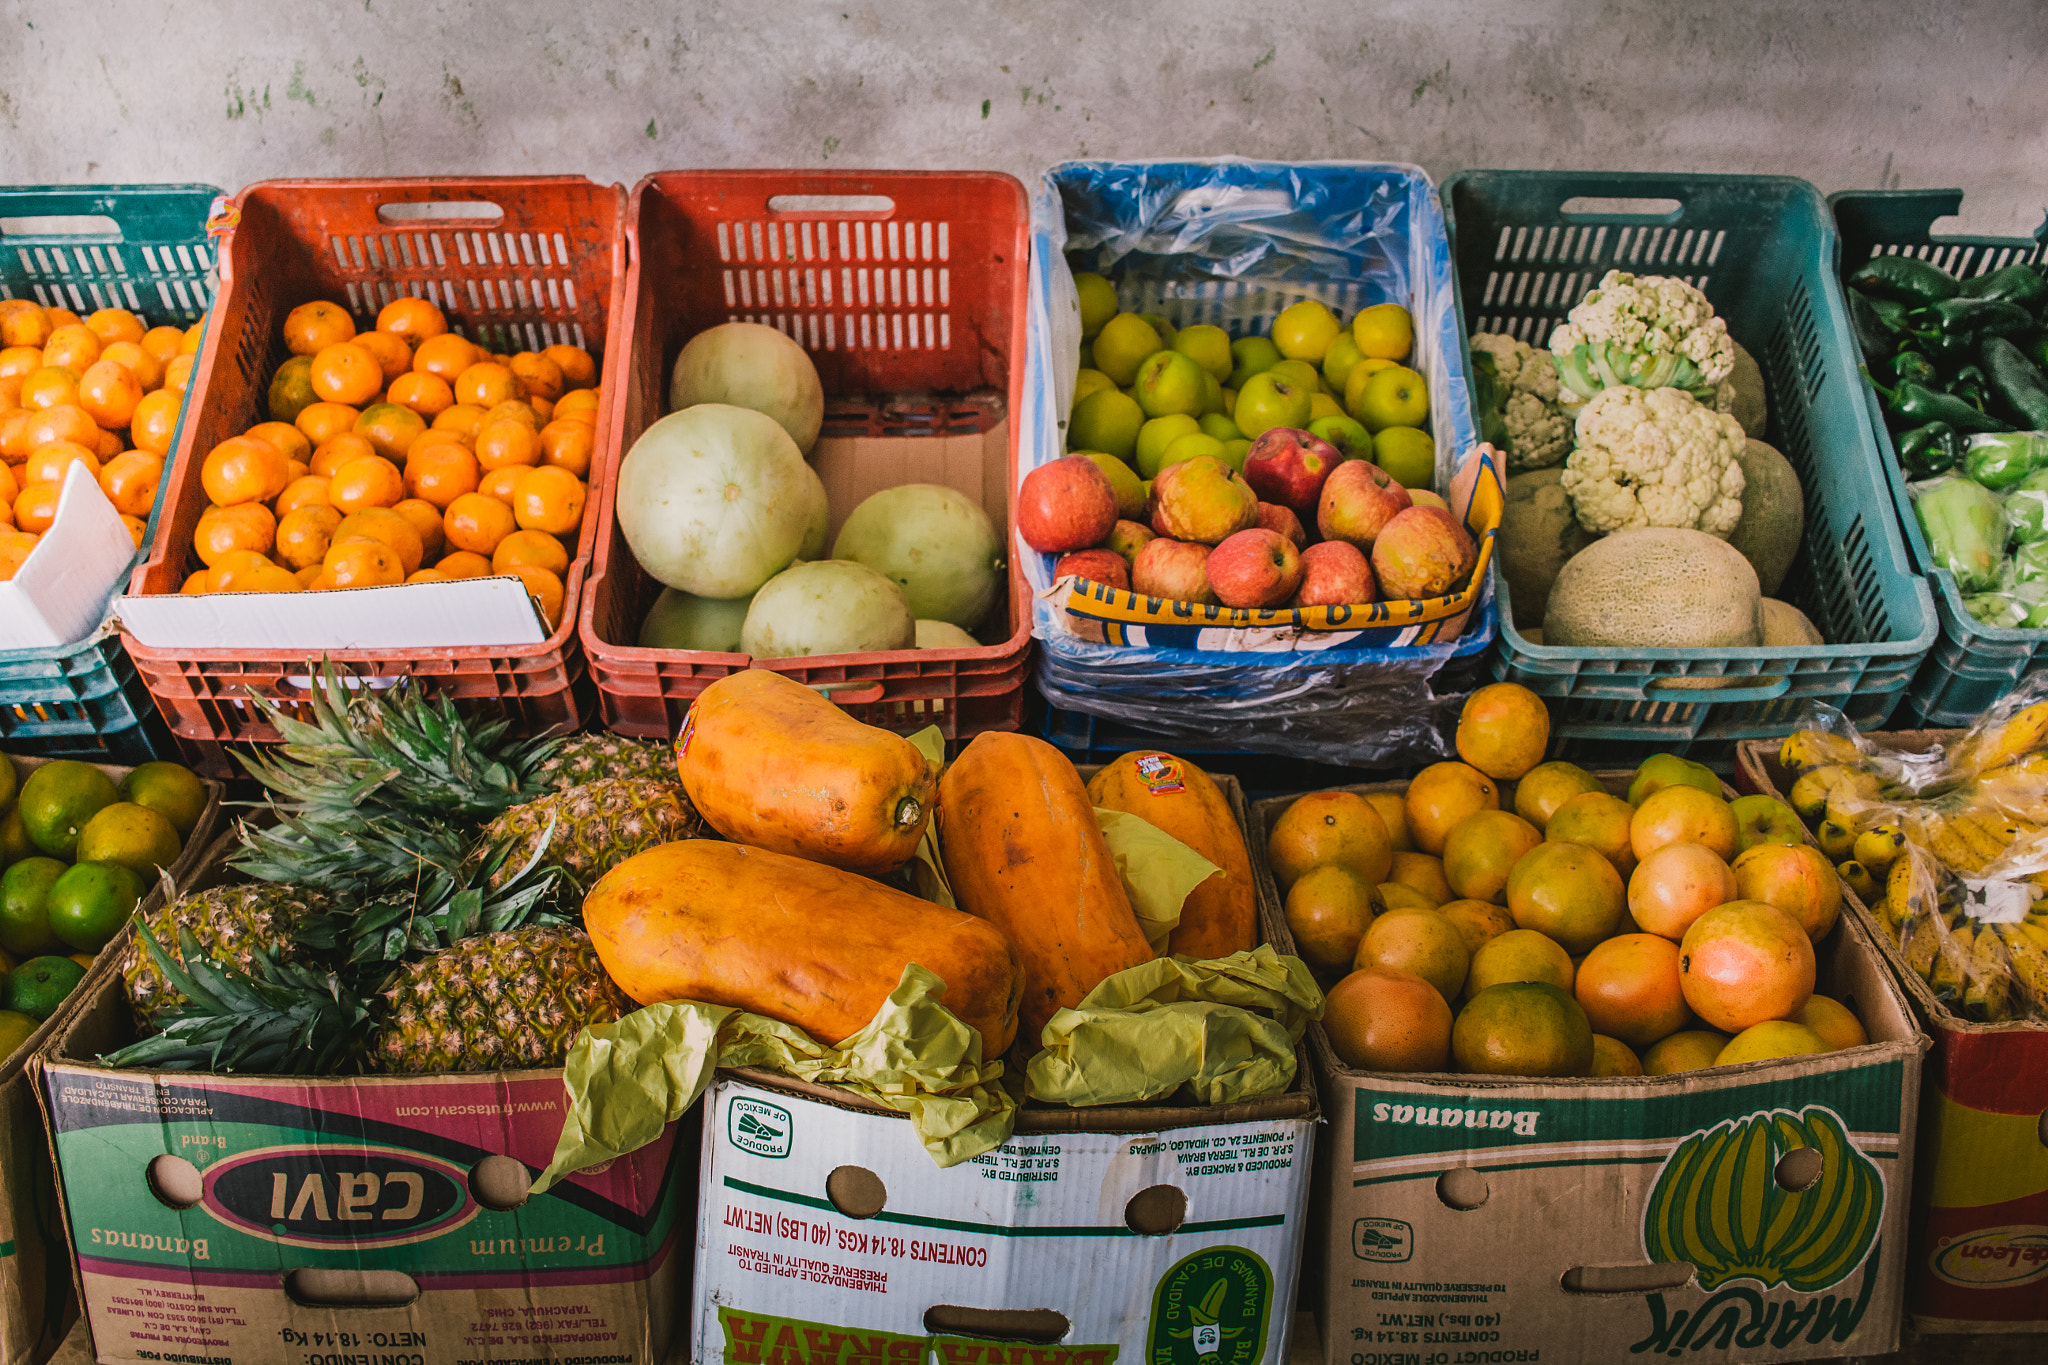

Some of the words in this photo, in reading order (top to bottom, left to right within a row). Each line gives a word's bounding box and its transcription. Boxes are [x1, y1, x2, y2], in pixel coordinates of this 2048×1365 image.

[64, 1087, 105, 1098] CALIDAD
[95, 1082, 140, 1093] TRANSITO
[156, 1088, 170, 1096] EN
[61, 1095, 137, 1112] THIABENDAZOLE
[120, 1093, 178, 1105] CONSERVAR
[182, 1098, 206, 1106] PARA
[139, 1104, 150, 1113] DE
[154, 1105, 213, 1115] APLICACION
[396, 1101, 557, 1118] www.frutascavi.com
[737, 1103, 771, 1116] MEXICO
[773, 1112, 786, 1121] OF
[1373, 1103, 1541, 1136] Bananas
[181, 1135, 227, 1149] Brand
[736, 1135, 783, 1153] PRODUCE
[1211, 1138, 1226, 1148] CD.
[1228, 1136, 1241, 1146] 2A.
[1243, 1132, 1284, 1145] PONIENTE
[1004, 1145, 1016, 1154] DE
[1129, 1143, 1166, 1155] CHIAPAS
[1169, 1139, 1209, 1151] HIDALGO,
[1271, 1144, 1293, 1155] S.P.R.
[1018, 1146, 1061, 1156] CENTRAL
[1208, 1149, 1238, 1162] TIERRA
[1240, 1148, 1256, 1159] R.L.
[1257, 1147, 1269, 1157] DE
[968, 1155, 999, 1166] TIERR
[1001, 1158, 1018, 1168] R.L.
[1035, 1158, 1059, 1168] S.P.R.
[1177, 1152, 1206, 1164] BRAVA
[1020, 1159, 1032, 1169] DE
[1201, 1163, 1236, 1176] PACKED
[1238, 1163, 1243, 1172] &
[1246, 1158, 1292, 1172] PRODUCED
[981, 1169, 996, 1180] BY:
[999, 1171, 1058, 1182] DISTRIBUTED
[1186, 1167, 1199, 1177] BY:
[271, 1172, 424, 1236] cavi
[724, 1205, 773, 1232] NET.WT
[777, 1211, 808, 1240] LBS)
[812, 1222, 831, 1247] (40
[91, 1228, 210, 1260] Bananas
[835, 1229, 868, 1252] KGS.
[469, 1234, 606, 1260] Premium
[872, 1236, 906, 1258] 18.14
[728, 1244, 770, 1262] TRANSIT
[910, 1240, 987, 1268] CONTENTS
[1364, 1249, 1402, 1258] PRODUCE
[739, 1259, 752, 1270] TO
[773, 1254, 783, 1264] IN
[785, 1256, 829, 1272] QUALITY
[1202, 1256, 1225, 1269] DE
[755, 1262, 798, 1278] APPLIED
[833, 1264, 888, 1282] PRESERVE
[801, 1270, 887, 1293] THIABENDAZOLE
[1351, 1279, 1390, 1290] TRANSIT
[1392, 1282, 1402, 1290] IN
[1403, 1282, 1442, 1292] QUALITY
[137, 1287, 151, 1296] N.L.
[1166, 1263, 1198, 1320] CALIDAD
[1230, 1259, 1259, 1317] BANANAS
[1444, 1283, 1492, 1292] PRESERVE
[1494, 1284, 1505, 1292] TO
[153, 1289, 205, 1301] MONTERREY,
[1371, 1292, 1410, 1301] APPLIED
[1412, 1294, 1488, 1303] THIABENDAZOLE
[106, 1306, 134, 1317] LINEAS
[167, 1302, 196, 1312] COSTO:
[198, 1305, 212, 1313] SIN
[215, 1306, 236, 1314] LADA
[517, 1304, 590, 1317] TAPACHULA,
[136, 1310, 145, 1318] 10
[148, 1311, 164, 1320] CON
[166, 1313, 186, 1322] 5353
[483, 1308, 514, 1318] CHIS.
[525, 1319, 554, 1331] (962)
[557, 1318, 607, 1330] TEL./FAX
[1377, 1313, 1434, 1327] NET.WT.
[1439, 1313, 1471, 1327] lbs.)
[1475, 1313, 1500, 1327] (40
[142, 1322, 157, 1330] C.V.
[471, 1323, 498, 1333] 7472
[502, 1322, 521, 1332] 626
[163, 1335, 172, 1343] DE
[278, 1327, 308, 1346] Kg.
[314, 1332, 361, 1347] 18.14
[367, 1332, 426, 1347] NETO:
[507, 1336, 528, 1344] S.A.
[532, 1332, 617, 1344] AGROPACIFICO
[1350, 1327, 1373, 1342] kg.
[1377, 1331, 1418, 1343] 18.14
[1424, 1331, 1500, 1343] CONTENTS
[175, 1336, 230, 1347] PROVEEDORA
[464, 1336, 485, 1346] C.V.
[488, 1336, 503, 1345] DE
[136, 1350, 161, 1361] POR:
[163, 1353, 232, 1365] DISTRIBUIDO
[303, 1354, 424, 1365] CONTENIDO:
[564, 1354, 632, 1365] PRODUCIDO
[1350, 1352, 1420, 1365] MEXICO
[1425, 1352, 1448, 1365] OF
[1453, 1349, 1540, 1364] PRODUCT
